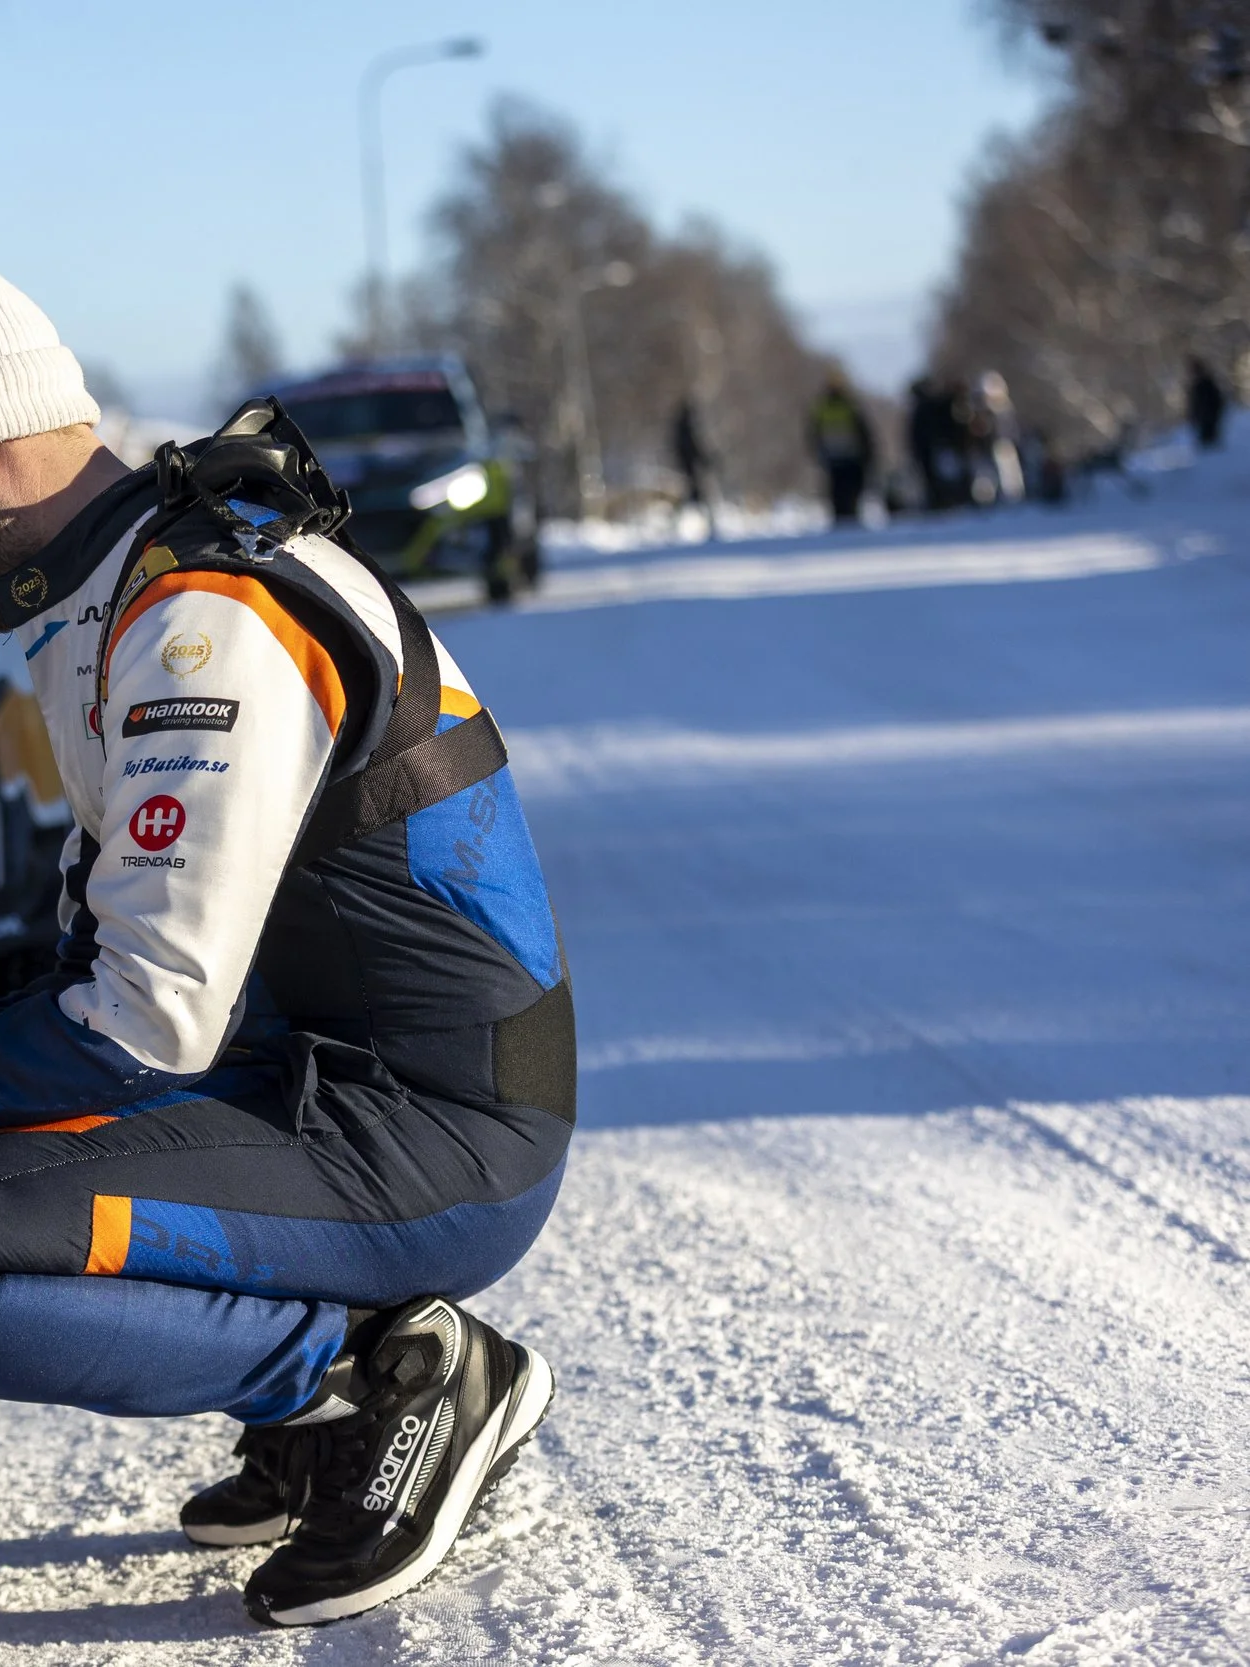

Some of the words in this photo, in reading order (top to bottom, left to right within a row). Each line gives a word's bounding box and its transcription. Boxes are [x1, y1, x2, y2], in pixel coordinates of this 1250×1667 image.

[16, 575, 41, 597] 2025
[169, 645, 205, 657] 2025
[162, 717, 191, 726] driving
[193, 717, 228, 726] emotion
[121, 856, 186, 869] TRENDAB
[363, 1415, 421, 1512] sparco
